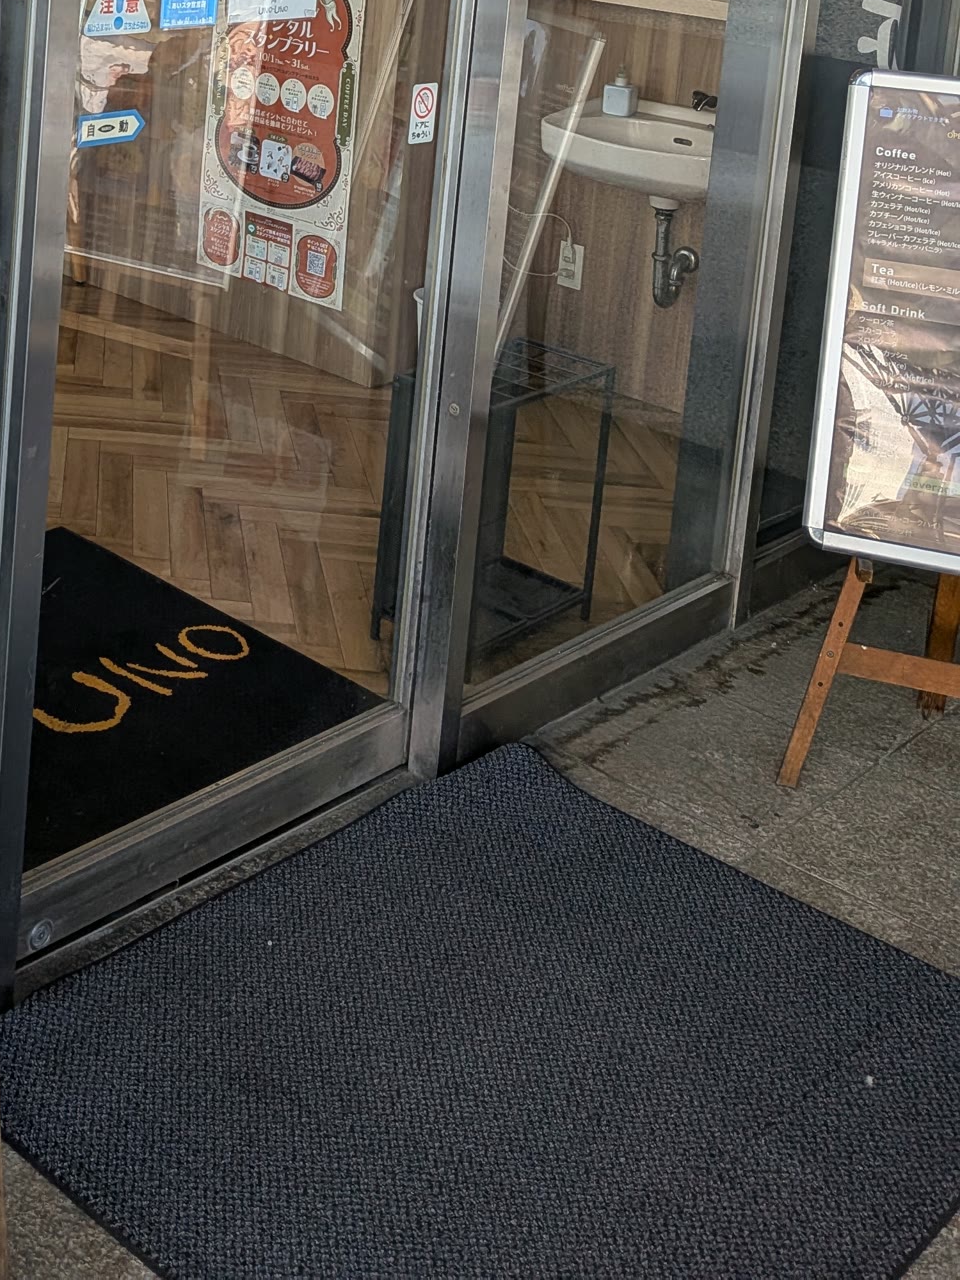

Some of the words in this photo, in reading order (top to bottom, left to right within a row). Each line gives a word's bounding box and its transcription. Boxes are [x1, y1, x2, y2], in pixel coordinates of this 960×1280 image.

[244, 29, 330, 58] スタンプラリー
[343, 78, 351, 110] COFFEE
[86, 119, 129, 138] 自動
[876, 147, 916, 159] Coffee
[875, 162, 935, 174] オリジナルブレンド
[873, 170, 921, 182] アイスコーヒー
[872, 180, 933, 193] アメリカンコーヒー
[870, 200, 903, 211] カフェラテ
[868, 220, 913, 232] カフェショコラ
[867, 230, 936, 245] フレーバーカフェラテ
[871, 263, 894, 276] Tea
[861, 301, 886, 313] Soft
[891, 305, 926, 319] Drink
[859, 315, 895, 327] ウーロン茶
[33, 625, 249, 734] UNO
